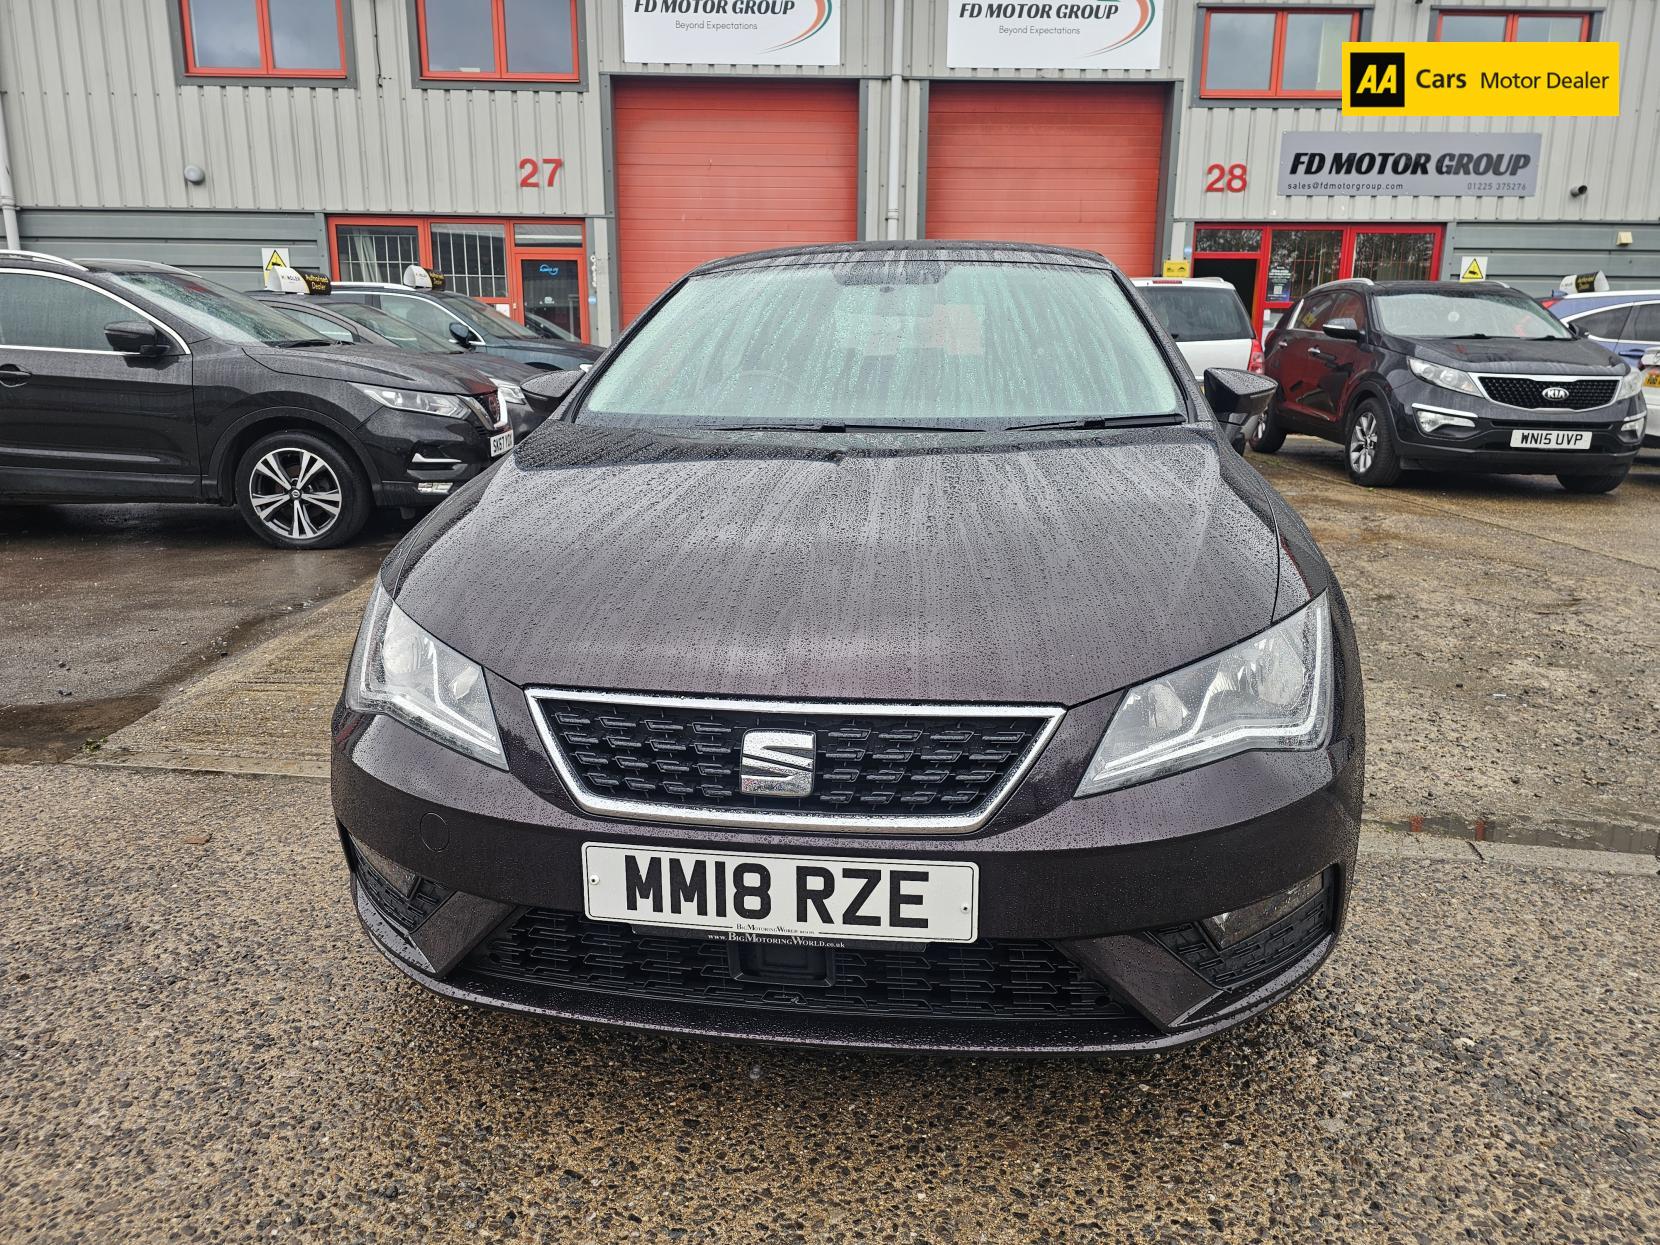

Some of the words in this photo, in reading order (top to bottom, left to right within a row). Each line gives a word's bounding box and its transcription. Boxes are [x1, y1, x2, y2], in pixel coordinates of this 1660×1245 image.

[634, 0, 657, 13] FD
[661, 0, 728, 14] MOTOR
[731, 0, 795, 14] GROUP
[959, 3, 983, 18] FD
[985, 3, 1053, 19] MOTOR
[1055, 3, 1119, 19] GROUP
[675, 20, 705, 30] Beyond
[706, 21, 758, 31] Expectations
[999, 25, 1028, 36] Beyond
[1030, 26, 1081, 36] Expectations
[1289, 152, 1326, 175] FD
[1328, 152, 1432, 175] MOTOR
[1434, 152, 1531, 176] GROUP
[518, 158, 563, 188] 27
[1205, 163, 1248, 193] 28
[1287, 181, 1404, 191] sales@fdmotorgroup.com
[1467, 182, 1493, 191] 01225
[1546, 389, 1567, 399] KIA
[1521, 432, 1552, 445] WN15
[1556, 433, 1583, 446] UVP
[624, 854, 771, 921] MM18
[796, 865, 929, 929] RZE
